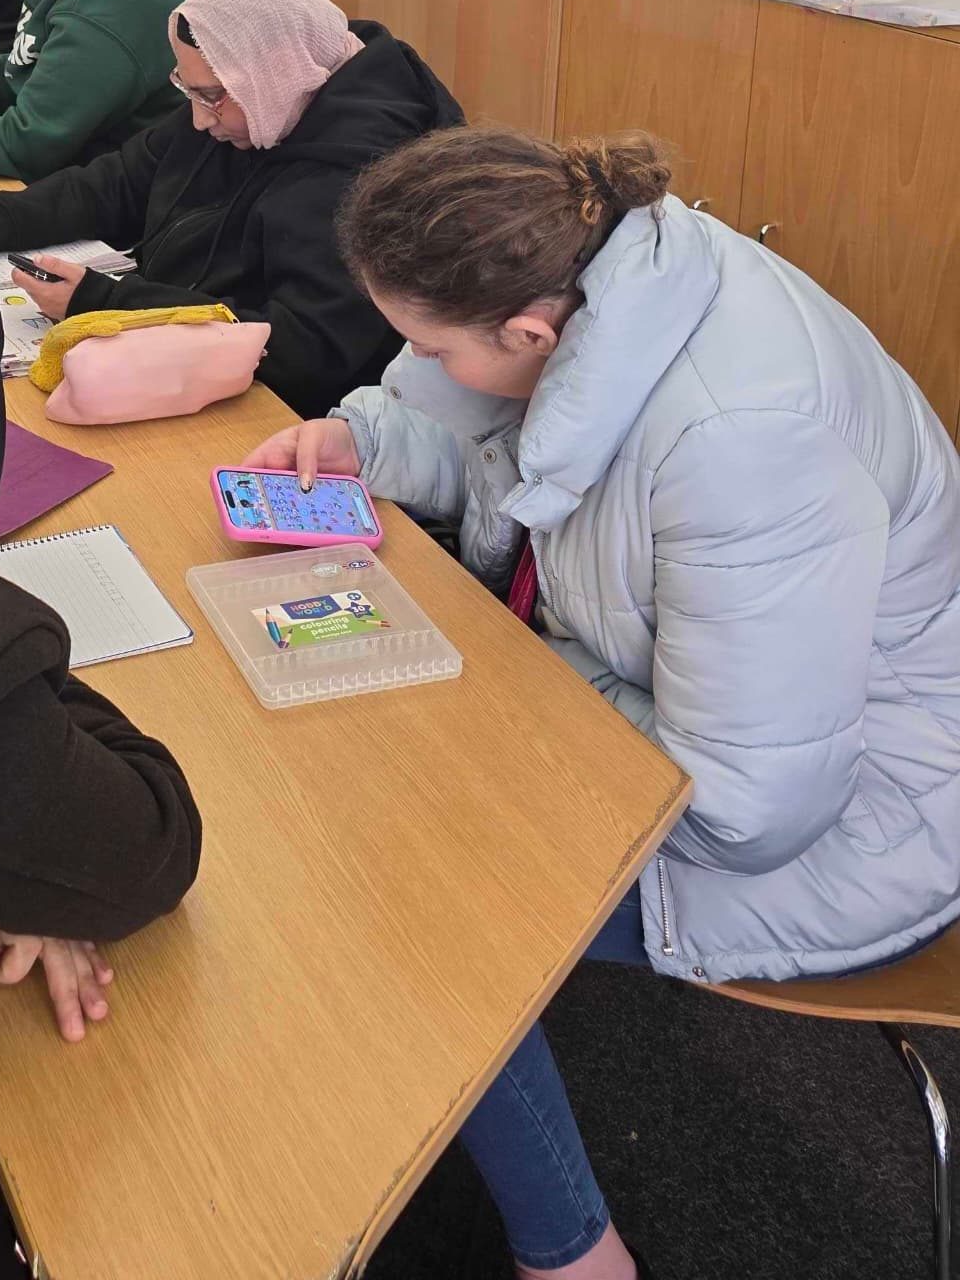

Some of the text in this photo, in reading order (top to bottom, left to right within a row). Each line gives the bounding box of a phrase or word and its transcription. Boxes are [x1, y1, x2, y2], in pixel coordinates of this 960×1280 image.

[290, 599, 327, 612] HOBBY
[296, 605, 334, 617] WORLD
[351, 605, 365, 614] 30
[300, 615, 351, 631] colouring
[311, 624, 349, 637] pencils
